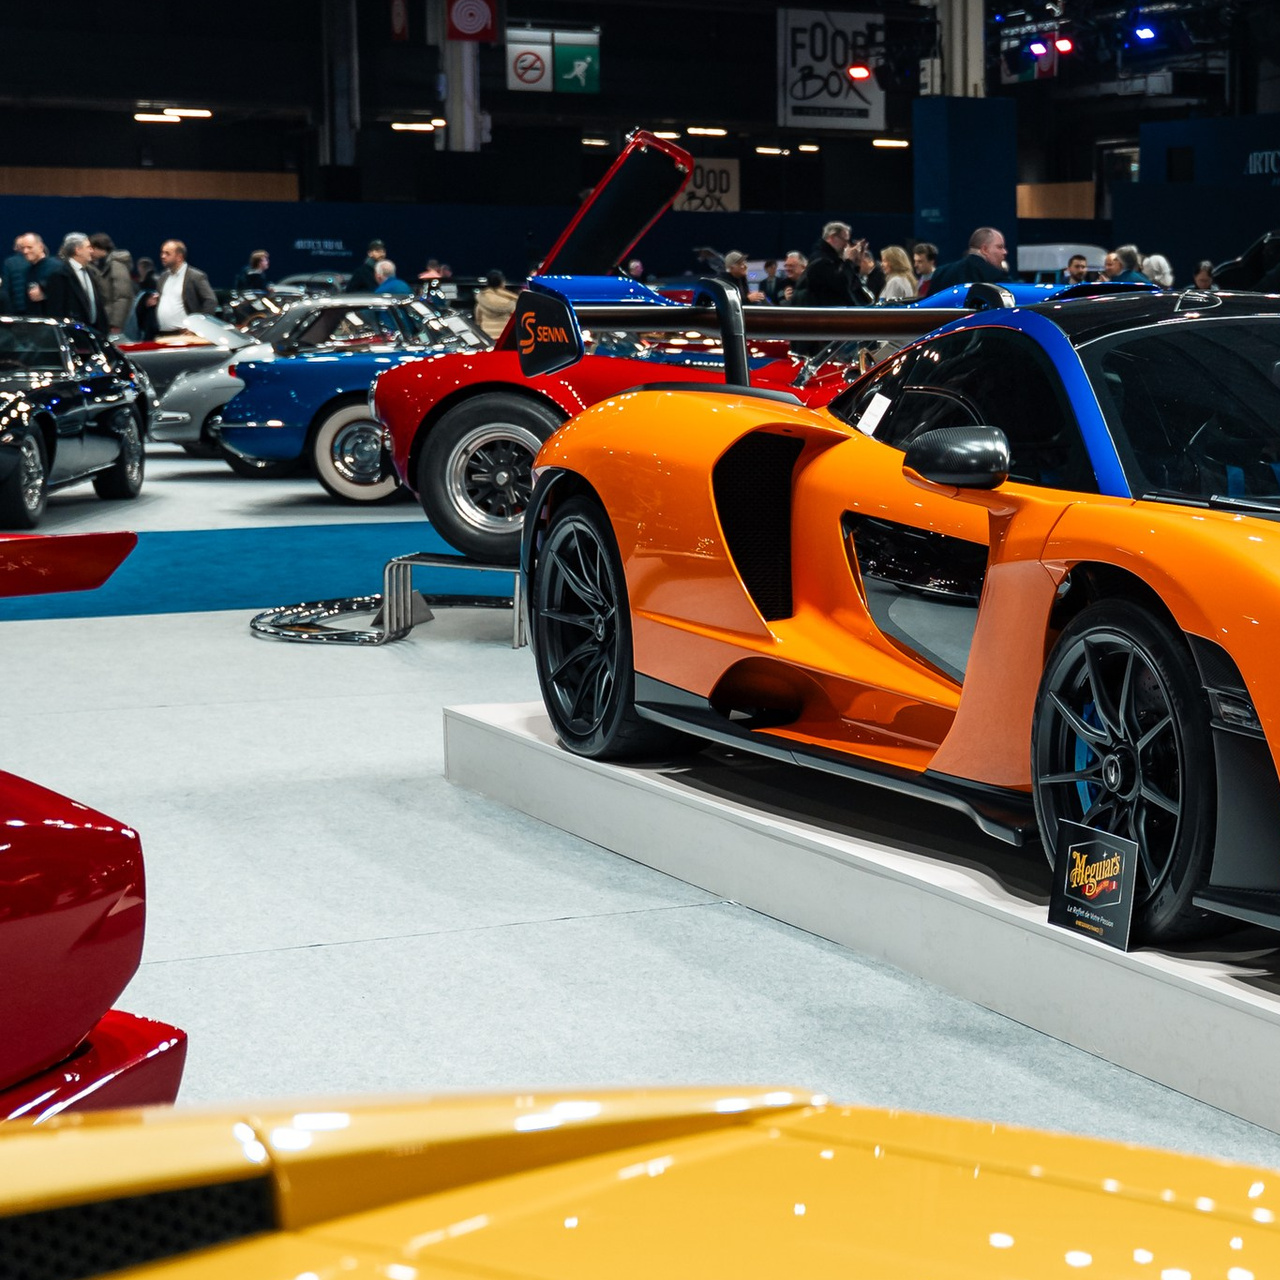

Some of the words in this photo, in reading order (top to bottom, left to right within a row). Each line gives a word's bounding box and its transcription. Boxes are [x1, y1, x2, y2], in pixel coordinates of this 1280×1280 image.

[693, 164, 730, 194] OOD
[537, 325, 569, 344] SENNA
[1070, 851, 1121, 896] Meguiar's
